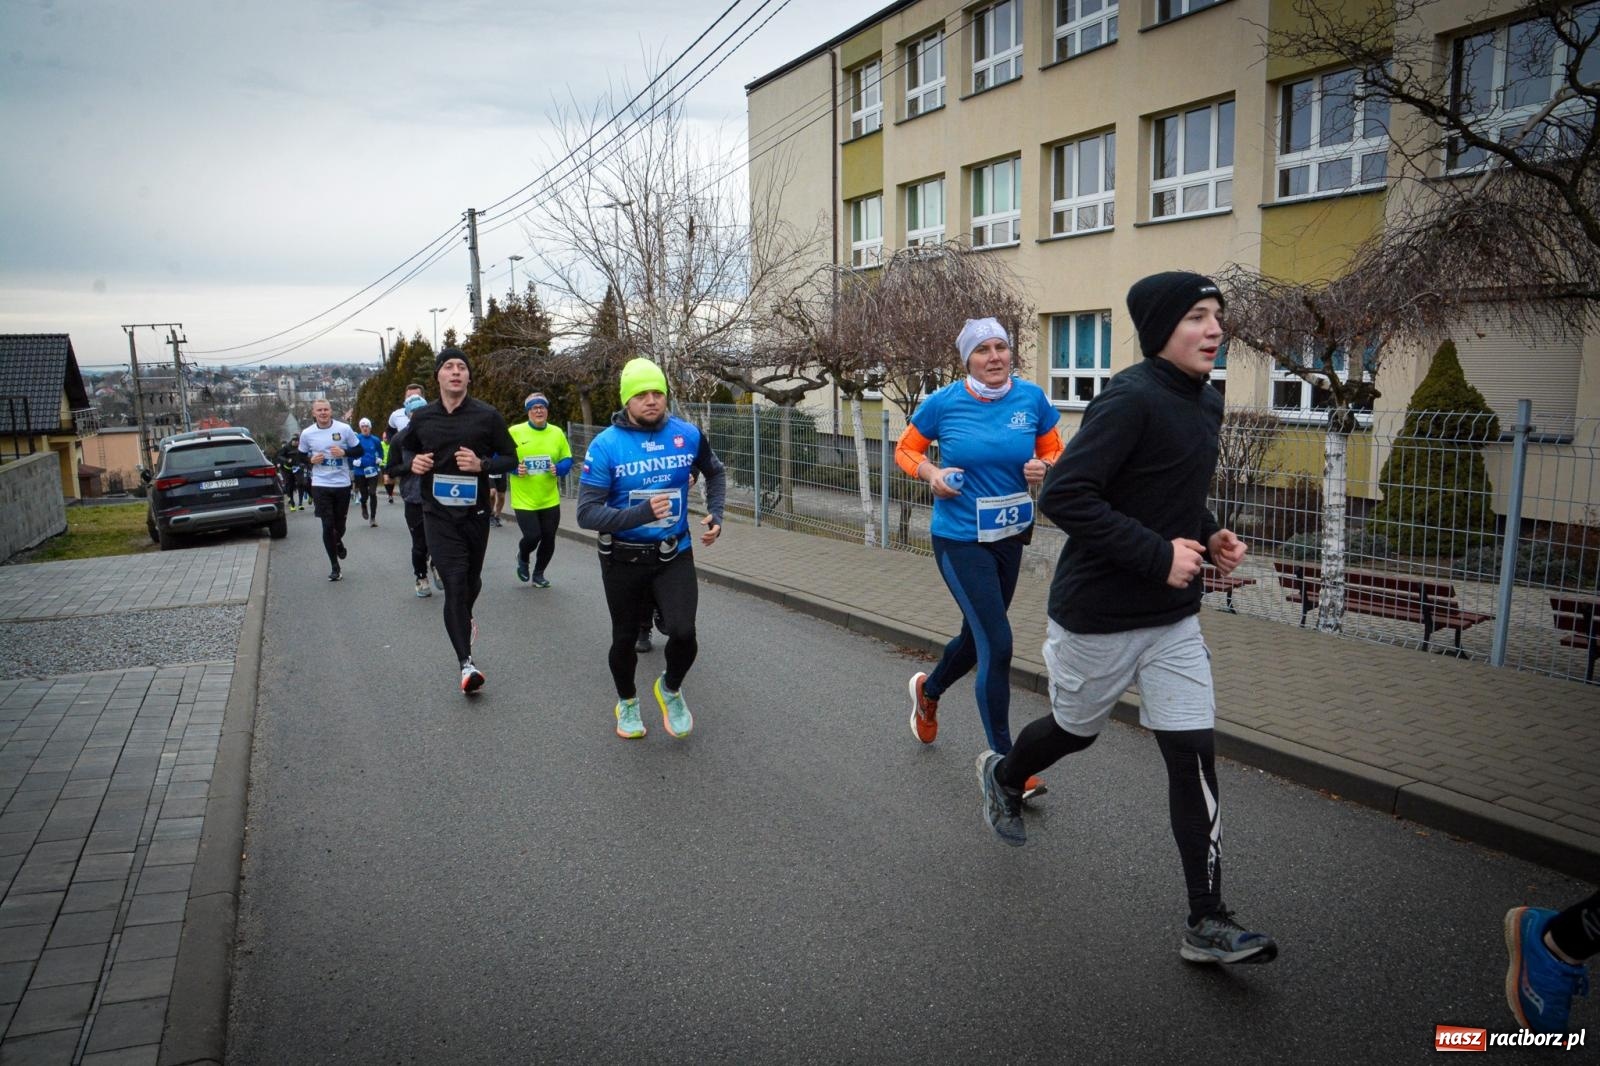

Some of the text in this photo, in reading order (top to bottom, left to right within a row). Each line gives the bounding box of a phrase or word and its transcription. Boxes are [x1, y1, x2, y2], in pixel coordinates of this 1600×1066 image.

[528, 460, 547, 470] 198
[615, 453, 695, 478] RUNNERS
[642, 473, 672, 486] JACEK
[450, 484, 460, 497] 6
[994, 506, 1019, 527] 43
